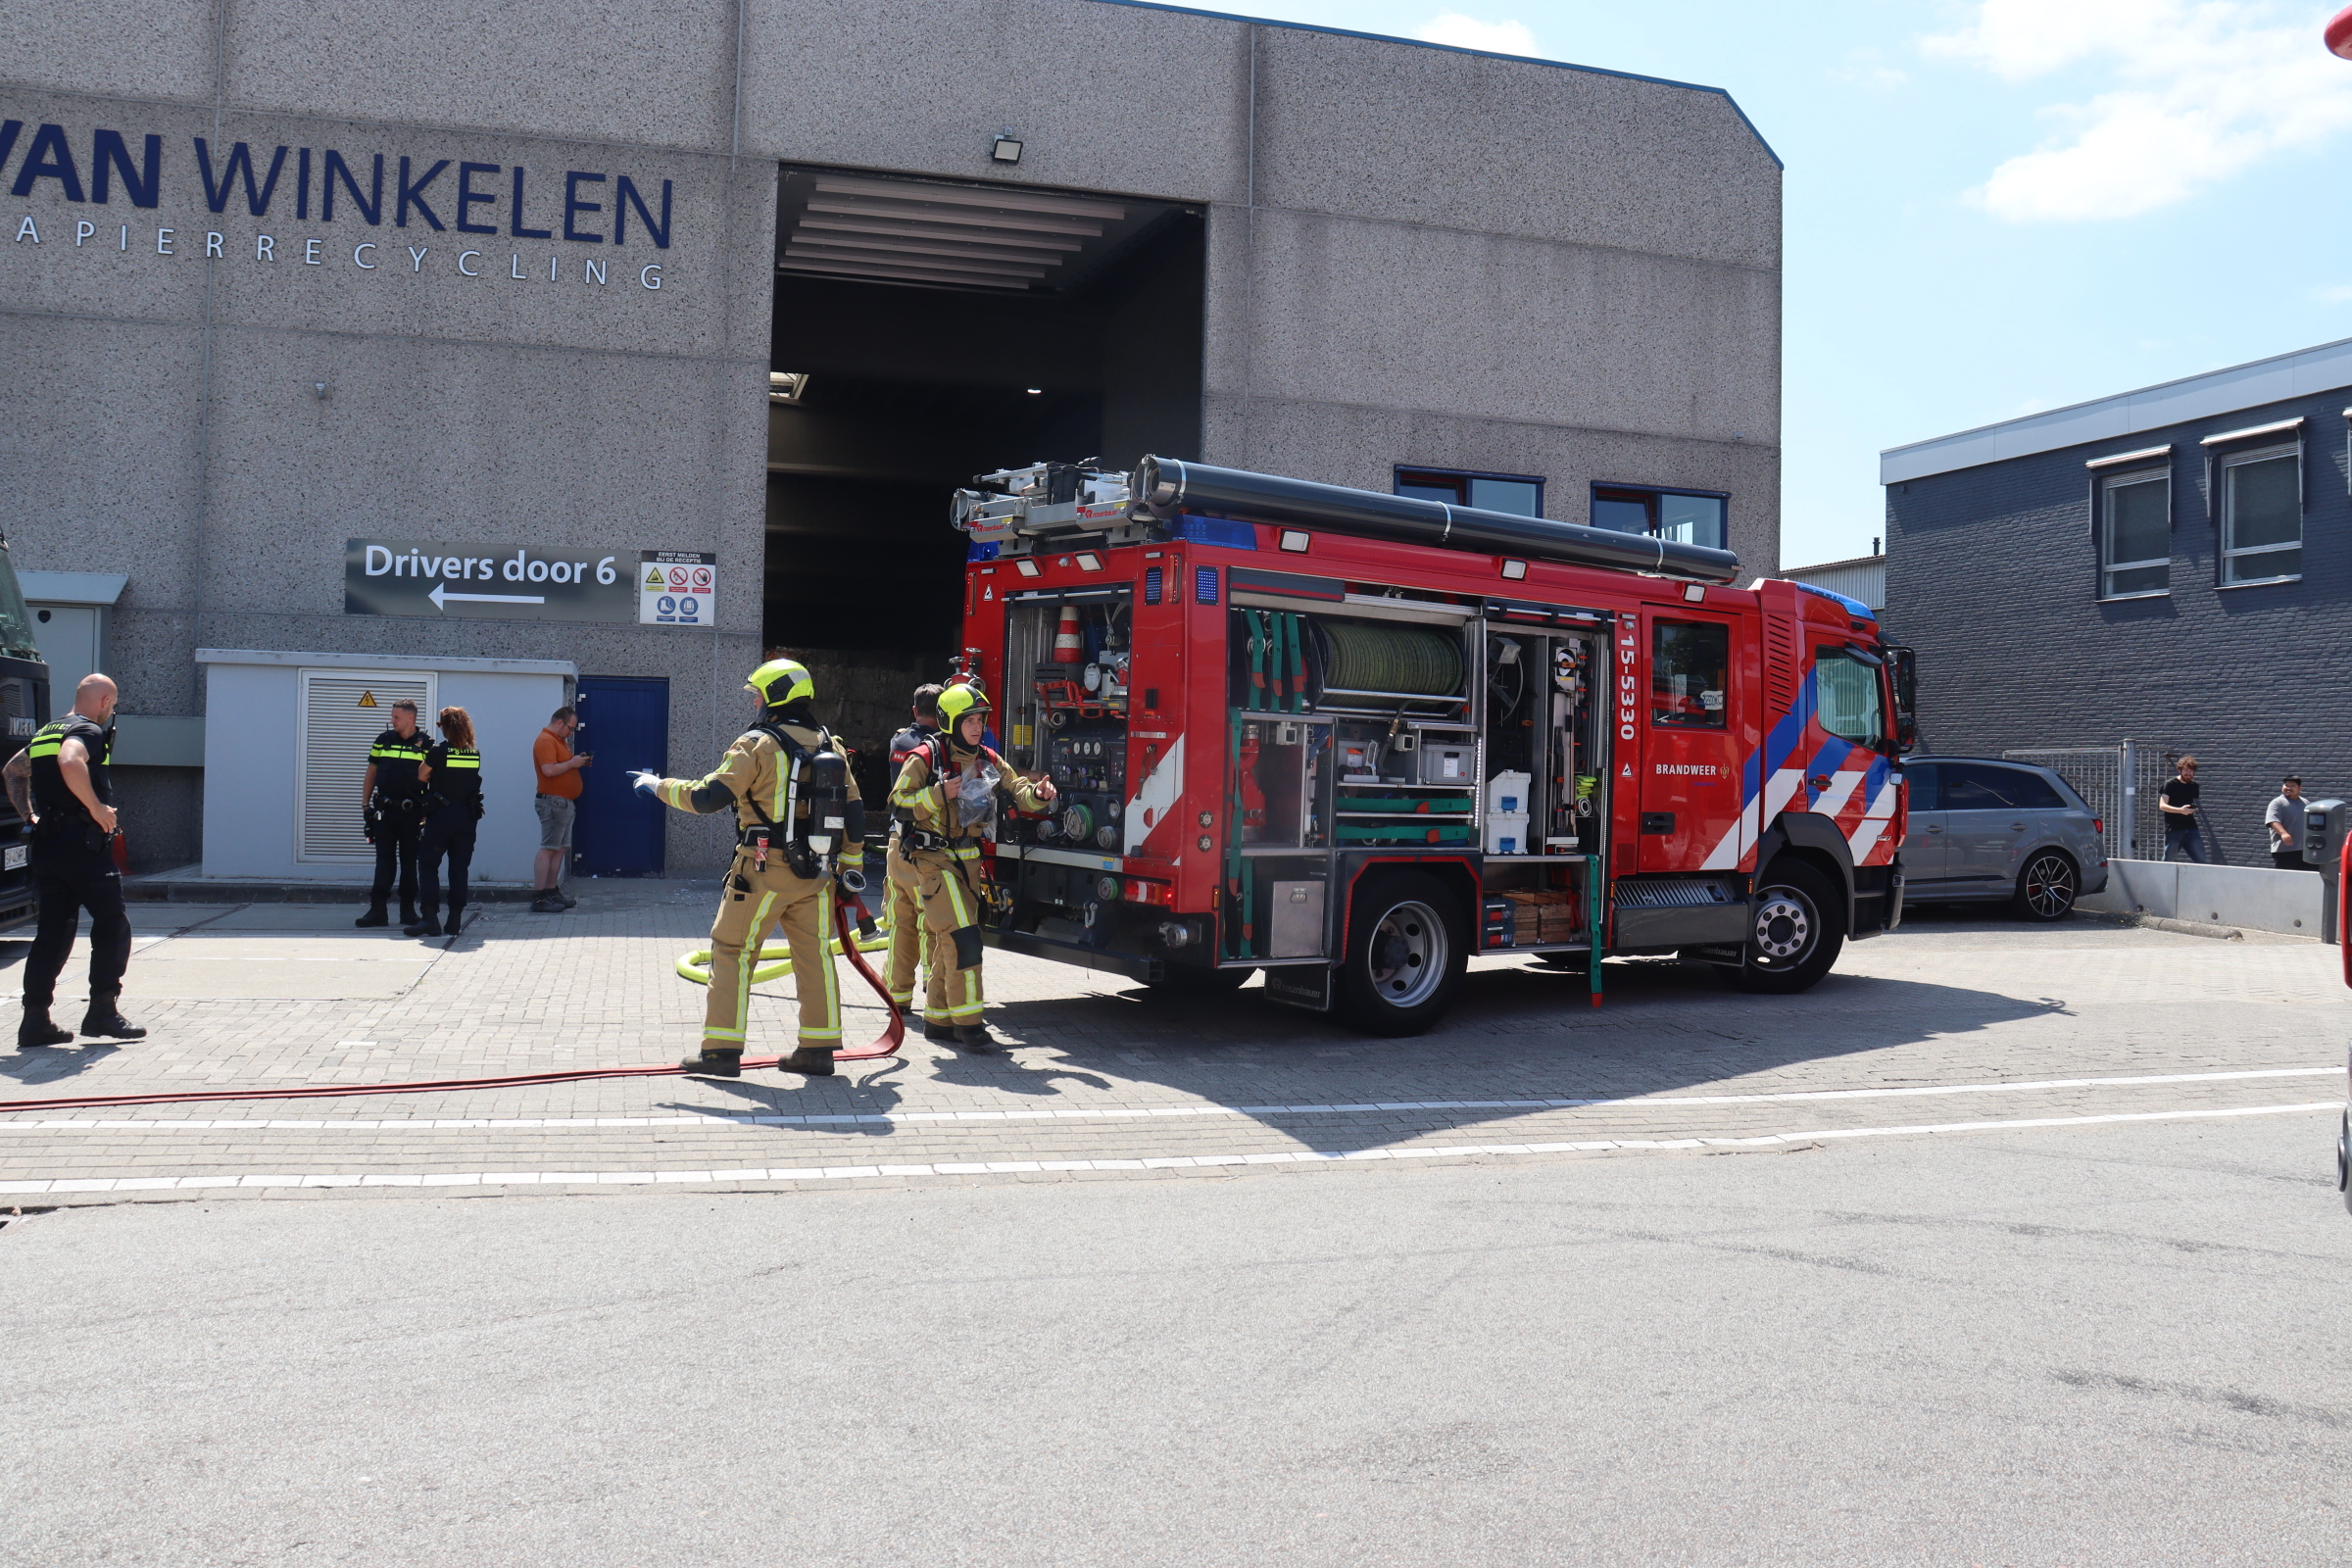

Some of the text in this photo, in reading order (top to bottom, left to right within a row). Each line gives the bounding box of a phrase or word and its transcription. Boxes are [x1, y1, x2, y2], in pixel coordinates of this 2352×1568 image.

[193, 136, 673, 249] WINKELEN
[15, 215, 663, 291] APIERRECYCLING
[1092, 508, 1118, 519] rosenbauer
[365, 545, 616, 586] Drivers door 6
[1620, 634, 1635, 741] 15-5330
[8, 716, 36, 737] IVECO
[1655, 763, 1717, 776] BRANDWEER
